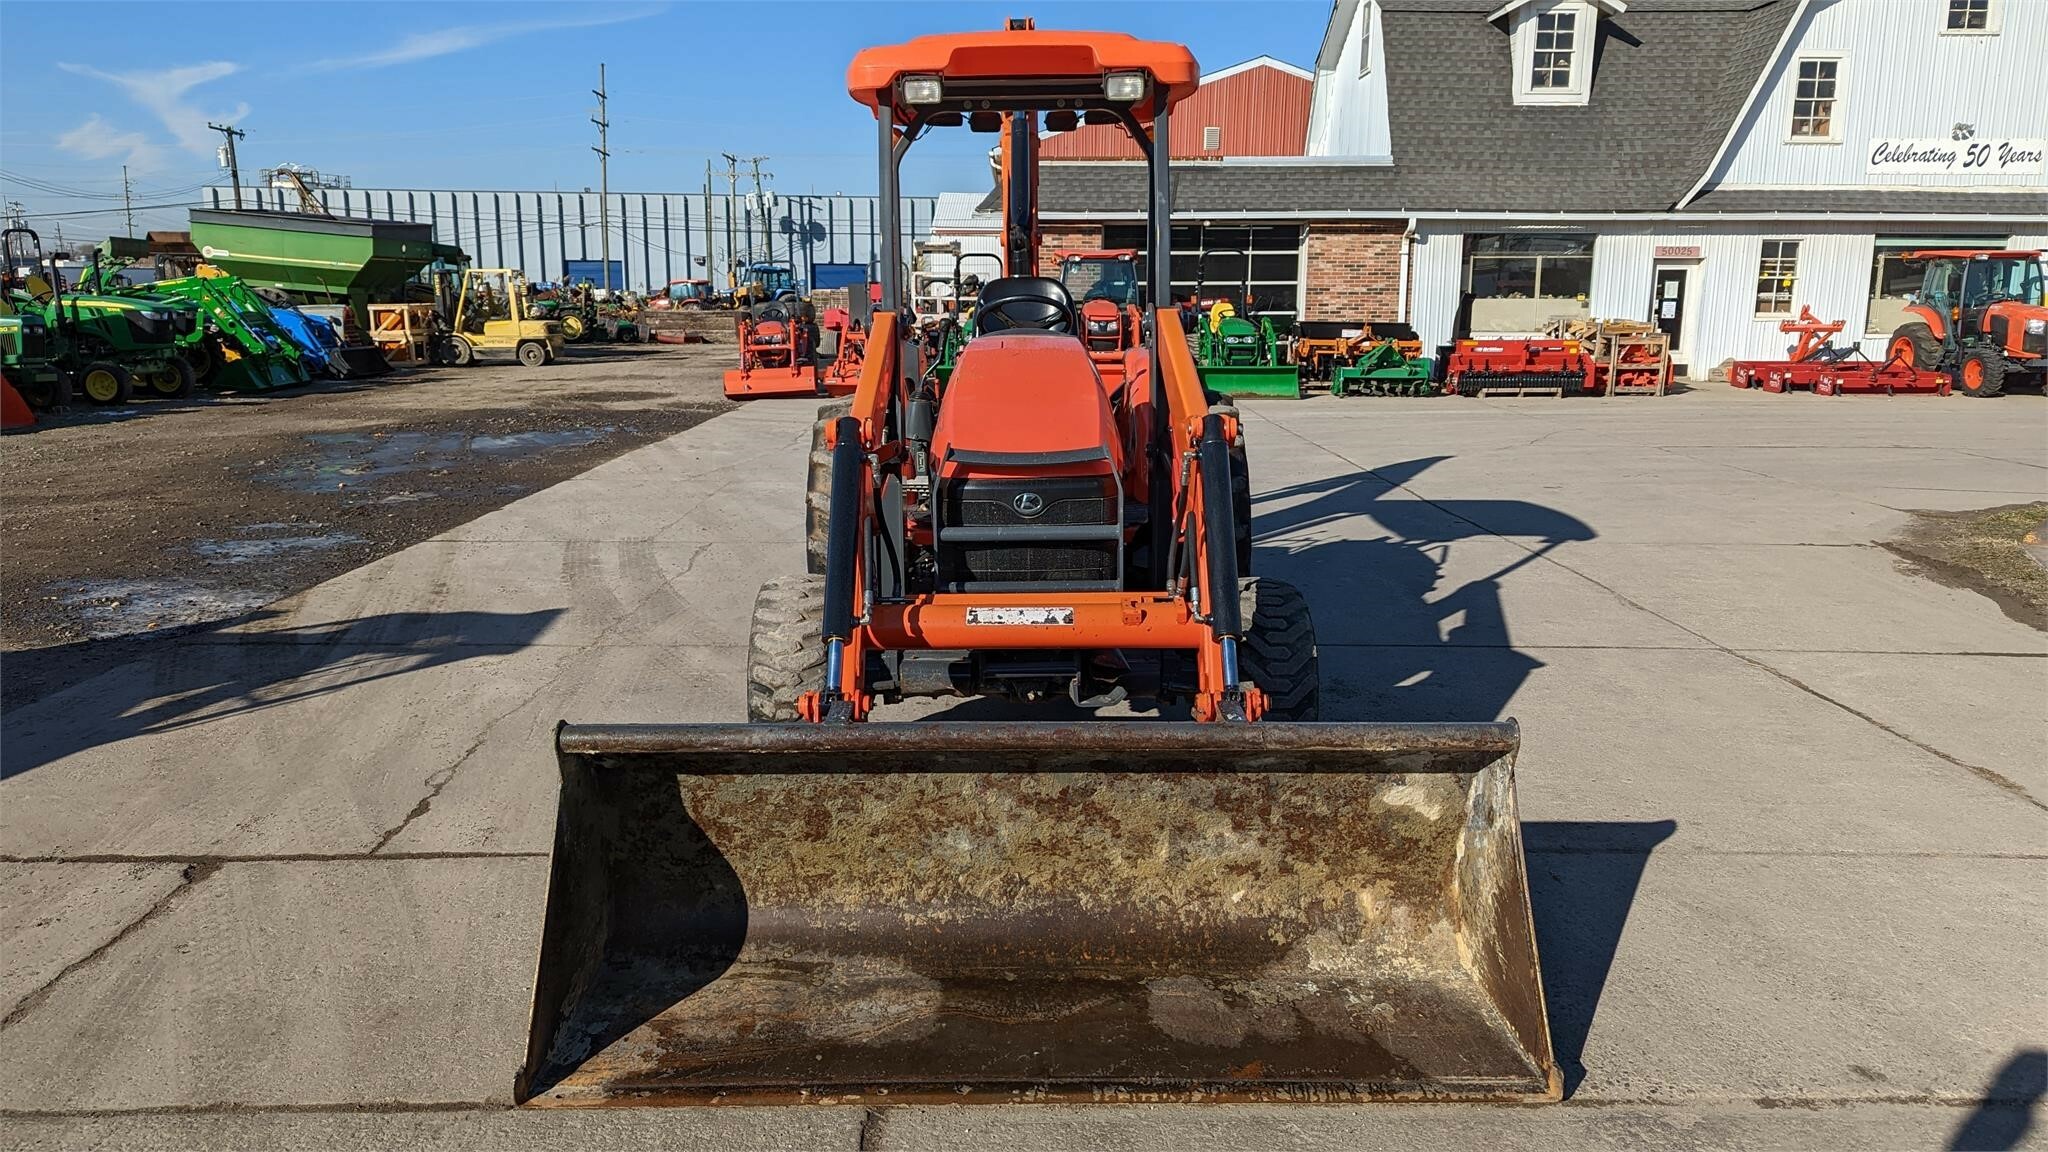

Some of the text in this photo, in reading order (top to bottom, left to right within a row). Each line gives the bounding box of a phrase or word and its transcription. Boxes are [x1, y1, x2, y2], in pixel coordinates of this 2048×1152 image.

[1871, 141, 2043, 170] Celebrating 50 Years
[1661, 246, 1693, 256] 50025
